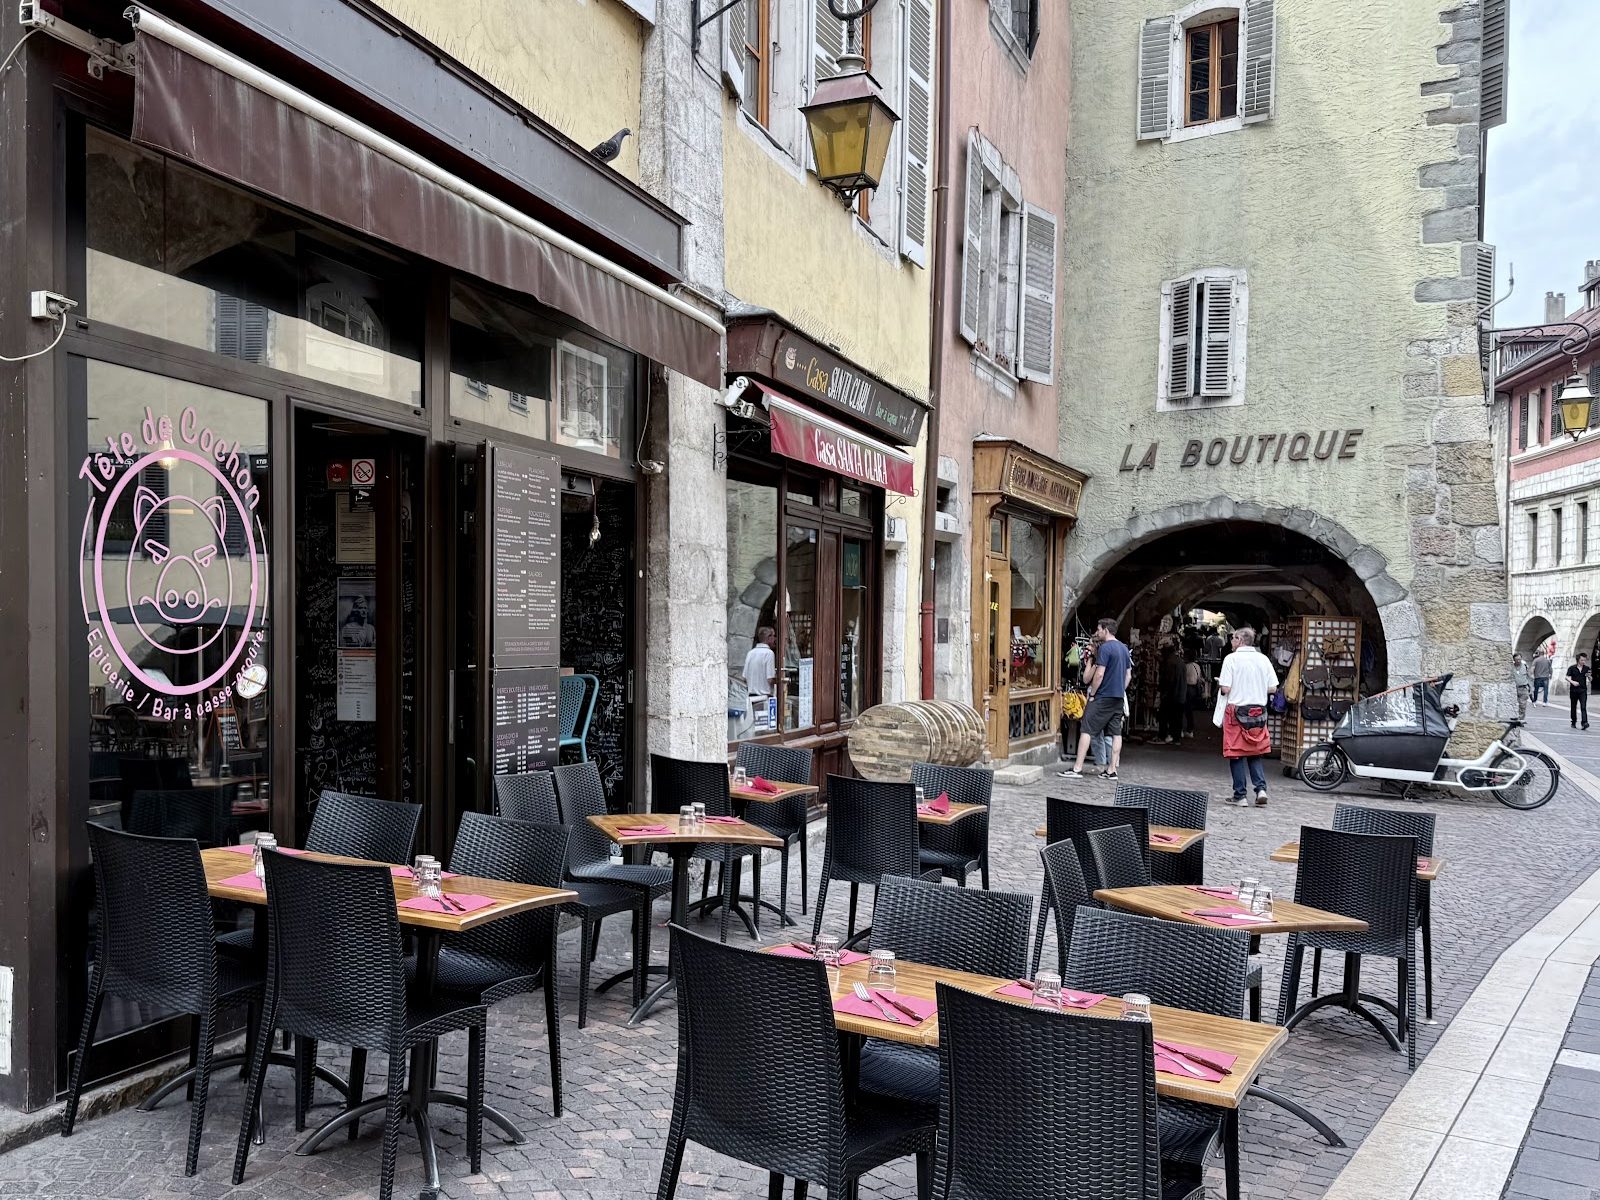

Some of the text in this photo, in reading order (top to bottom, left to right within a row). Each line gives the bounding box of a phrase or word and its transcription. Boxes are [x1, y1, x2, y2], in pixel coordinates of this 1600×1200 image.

[806, 357, 871, 414] Casa SANTA CLARA
[79, 406, 260, 510] Tête de Cochon
[814, 428, 888, 485] Casa SANTA CLARA
[1119, 428, 1364, 472] LA BOUTIQUE
[87, 627, 134, 702] Epicerie
[152, 697, 179, 721] Bar
[184, 702, 192, 720] à
